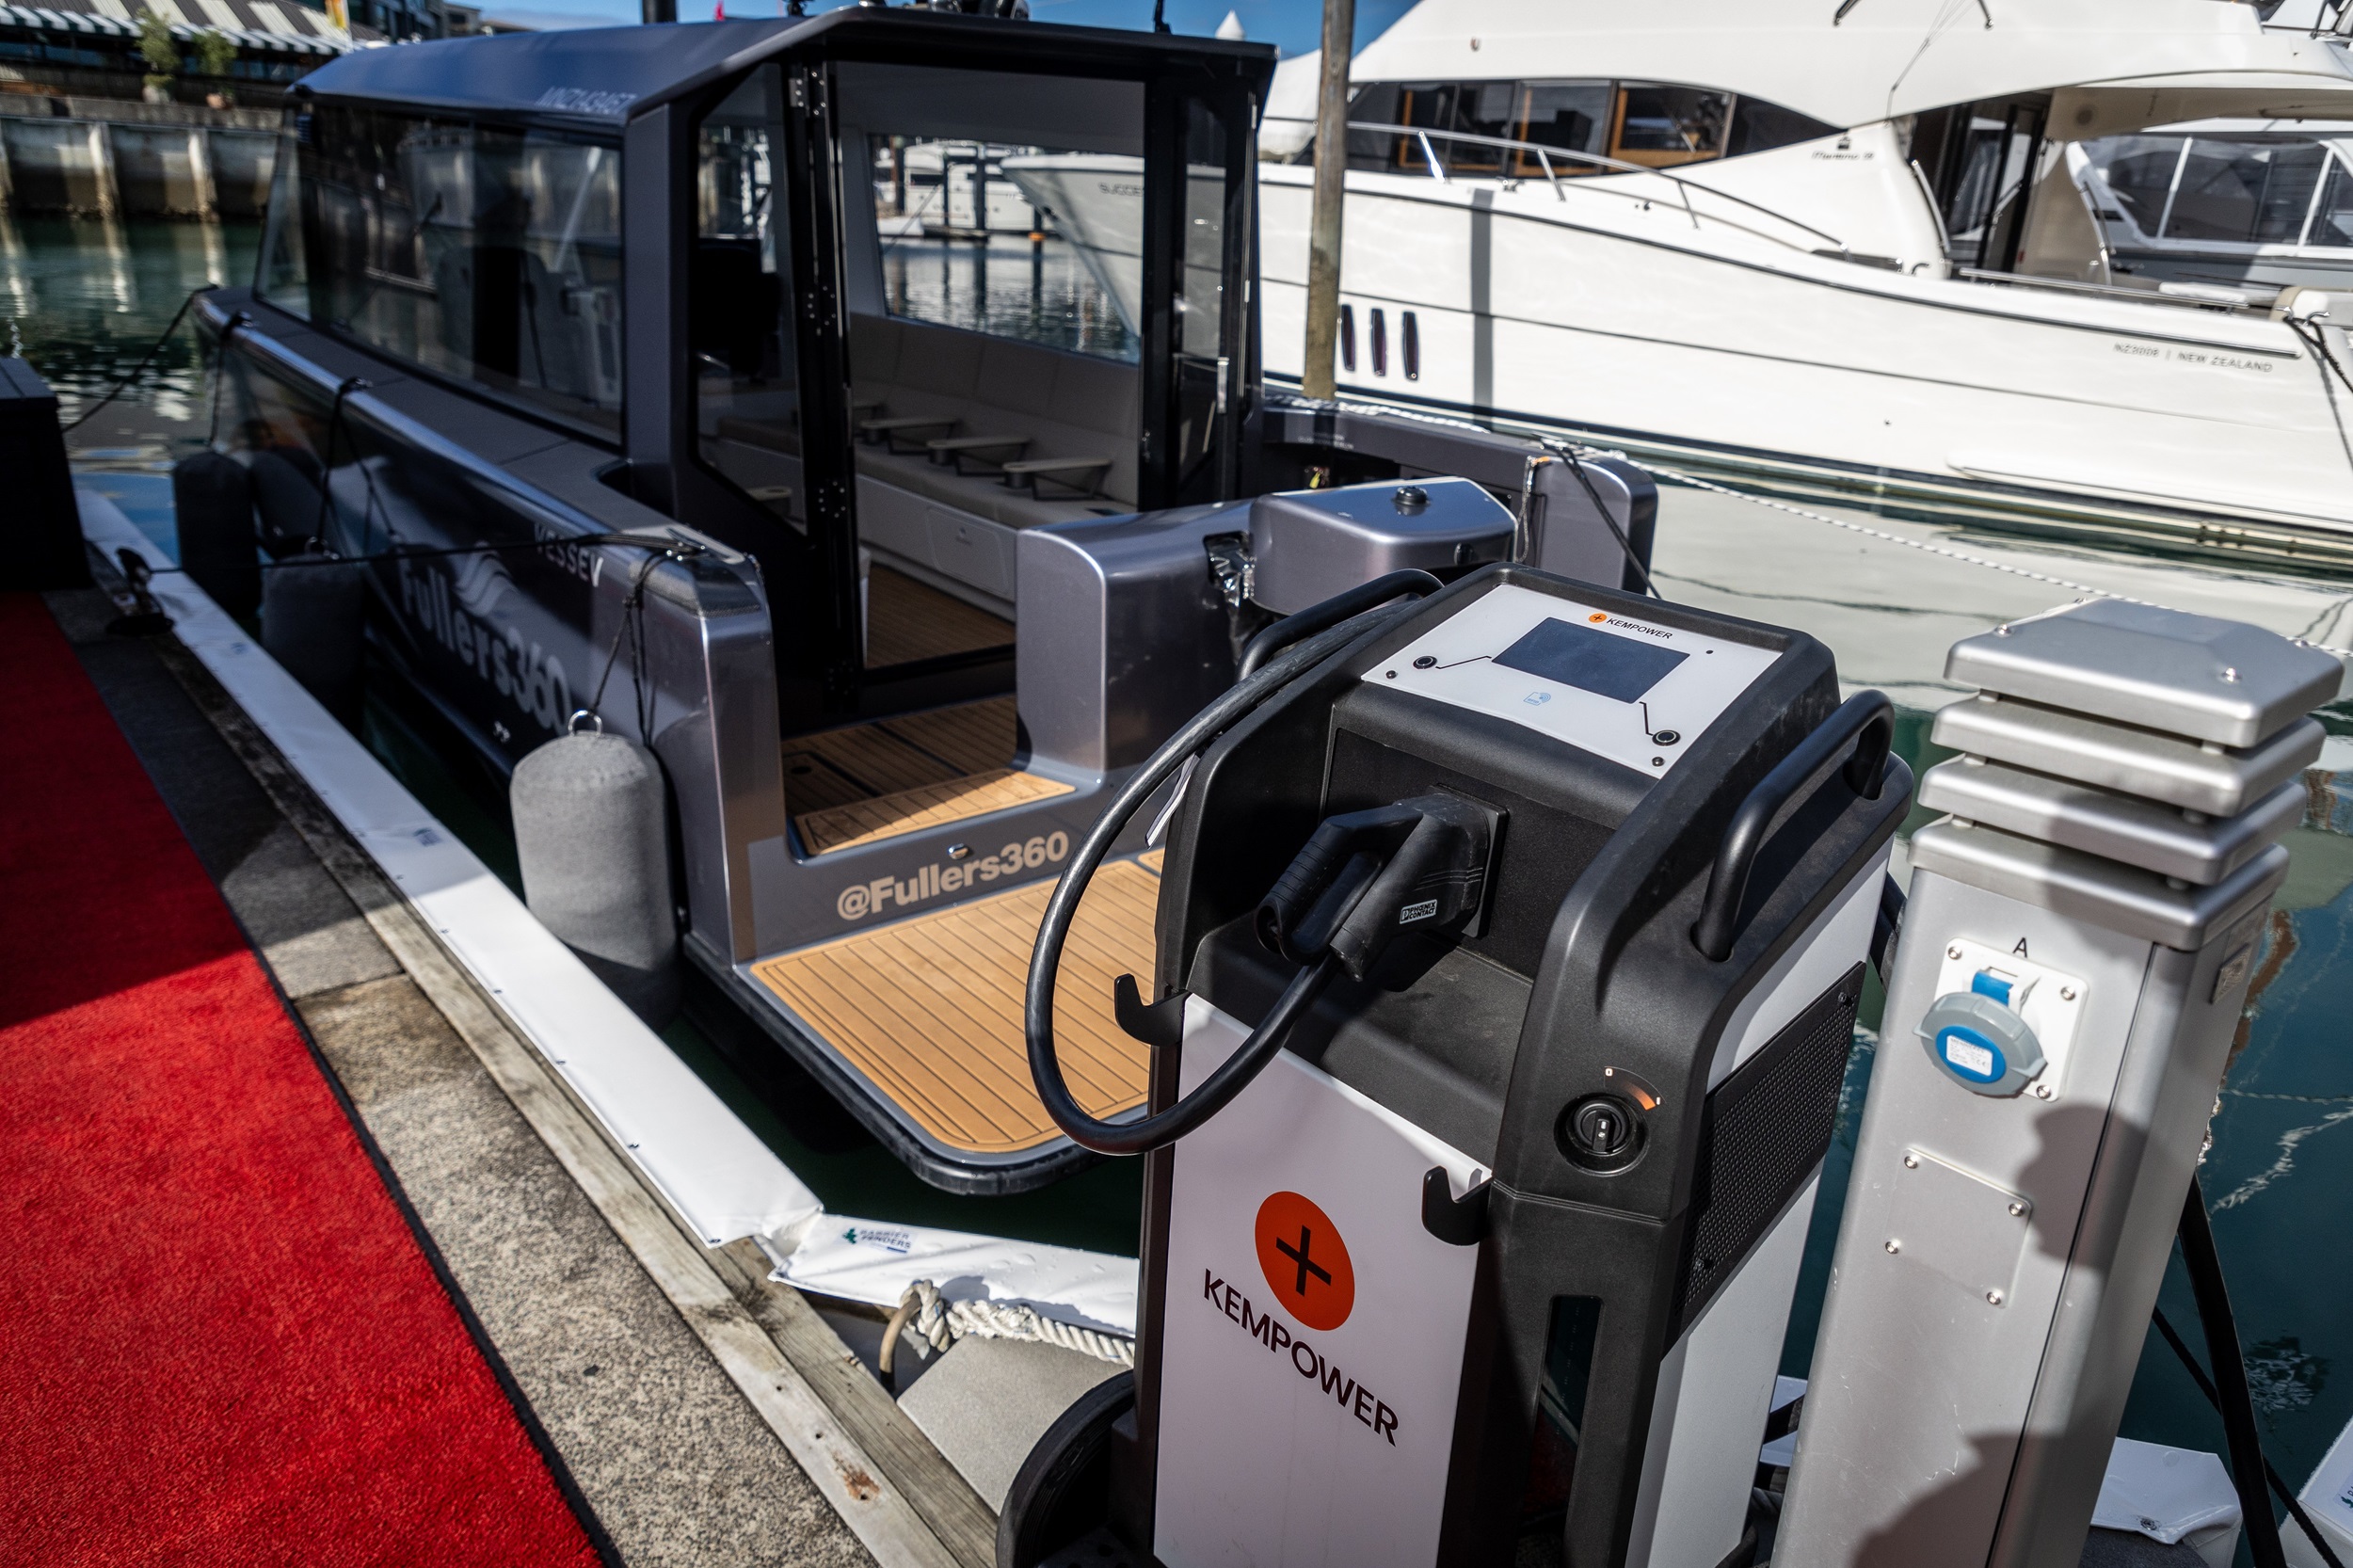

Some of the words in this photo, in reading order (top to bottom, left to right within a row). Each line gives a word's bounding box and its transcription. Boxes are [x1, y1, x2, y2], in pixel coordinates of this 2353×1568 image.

[2177, 350, 2207, 362] NEW
[2211, 356, 2273, 373] ZEALAND
[1607, 617, 1673, 639] KEMPOWER
[396, 546, 573, 736] Fullers360
[837, 830, 1069, 920] @Fullers360
[1409, 907, 1435, 919] CONTACT
[2012, 936, 2027, 958] A
[861, 1236, 911, 1249] FENDERS
[1204, 1268, 1399, 1448] KEMPOWER
